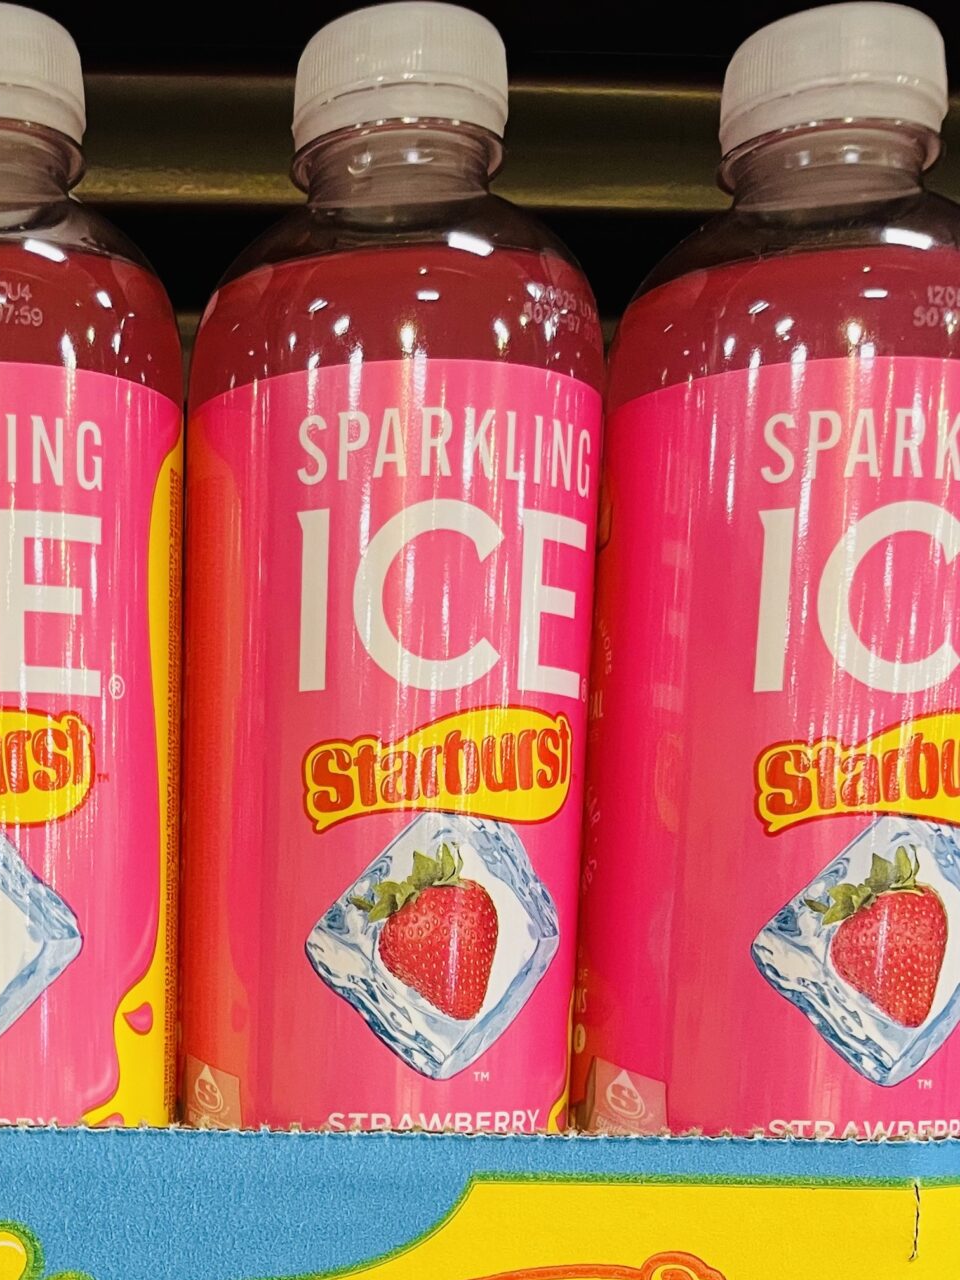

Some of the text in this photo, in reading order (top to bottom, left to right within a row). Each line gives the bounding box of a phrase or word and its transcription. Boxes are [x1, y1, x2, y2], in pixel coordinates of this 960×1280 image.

[296, 407, 591, 499] SPARKLING
[297, 500, 589, 700] ICE
[310, 717, 573, 815] Starburst
